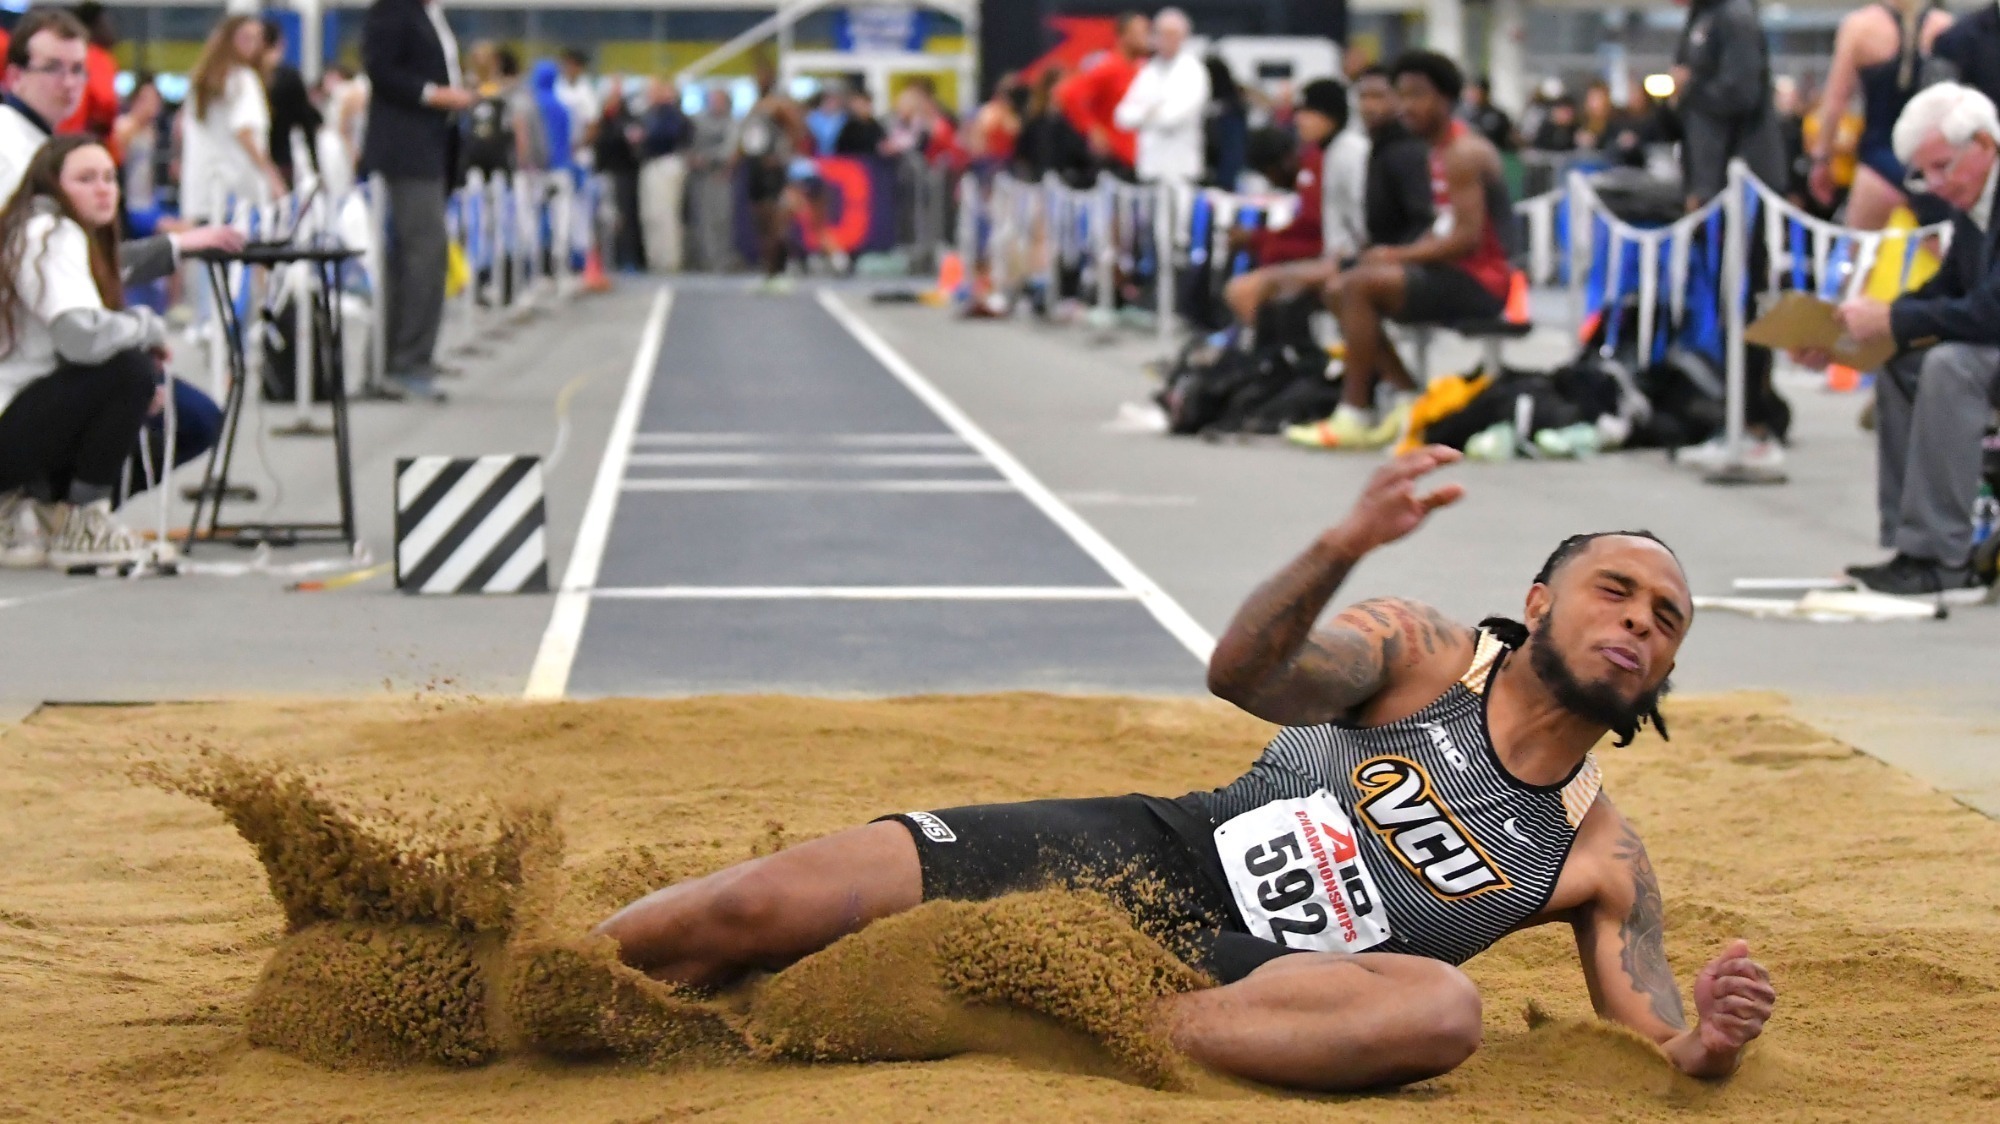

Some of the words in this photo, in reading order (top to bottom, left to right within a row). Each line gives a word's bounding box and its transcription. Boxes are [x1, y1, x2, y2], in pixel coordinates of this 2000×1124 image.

[1245, 831, 1328, 945] 592
[1295, 810, 1357, 943] CHAMPIONSHIPS
[1321, 822, 1373, 917] A10
[1357, 759, 1505, 896] VCU
